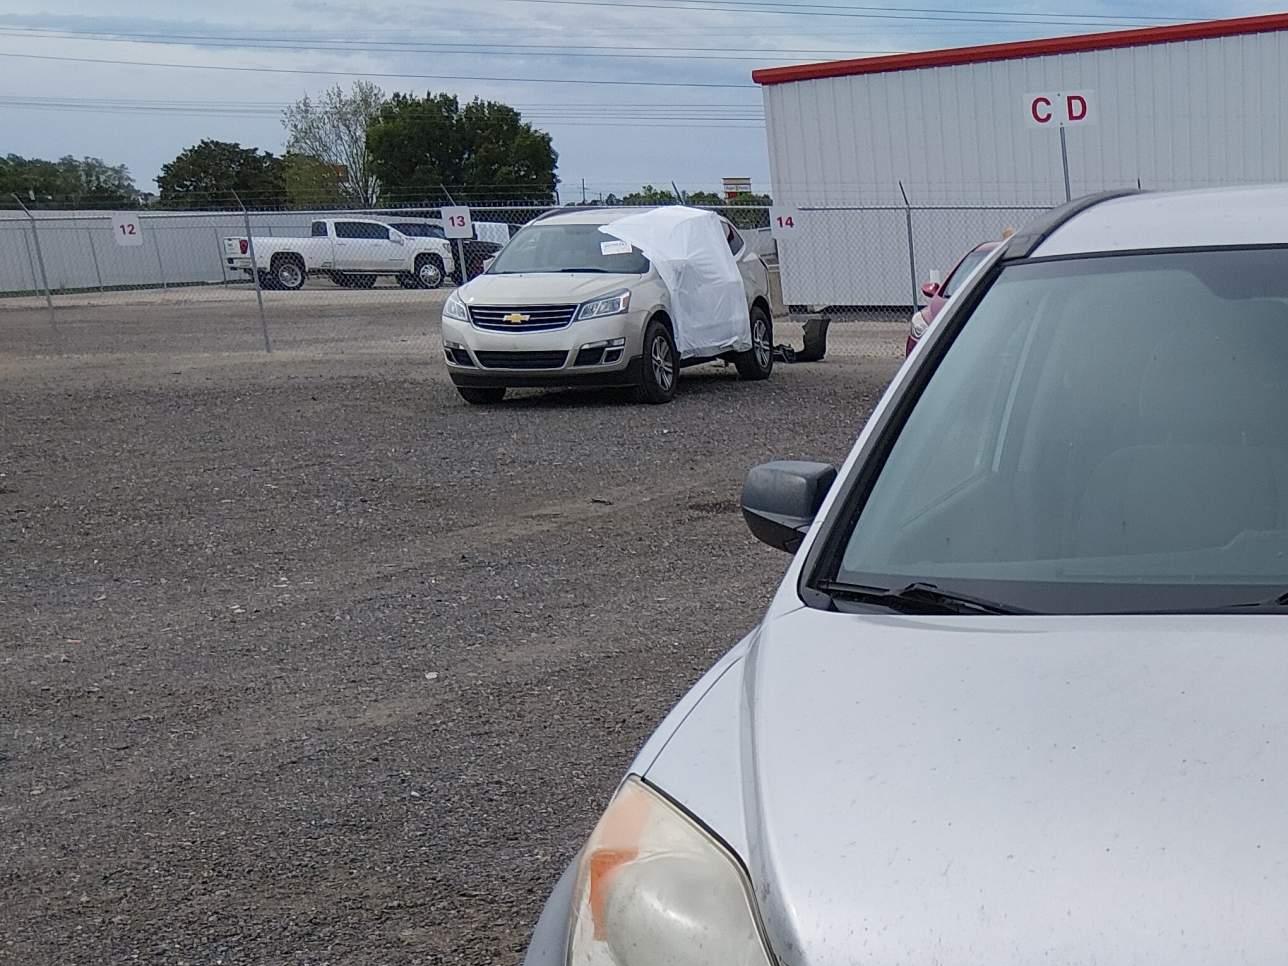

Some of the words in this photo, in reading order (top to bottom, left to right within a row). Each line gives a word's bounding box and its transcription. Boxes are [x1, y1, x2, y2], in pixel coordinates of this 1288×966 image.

[1031, 96, 1052, 124] C
[1066, 95, 1087, 121] D
[449, 215, 466, 227] 13
[776, 216, 795, 228] 14
[119, 223, 137, 235] 12
